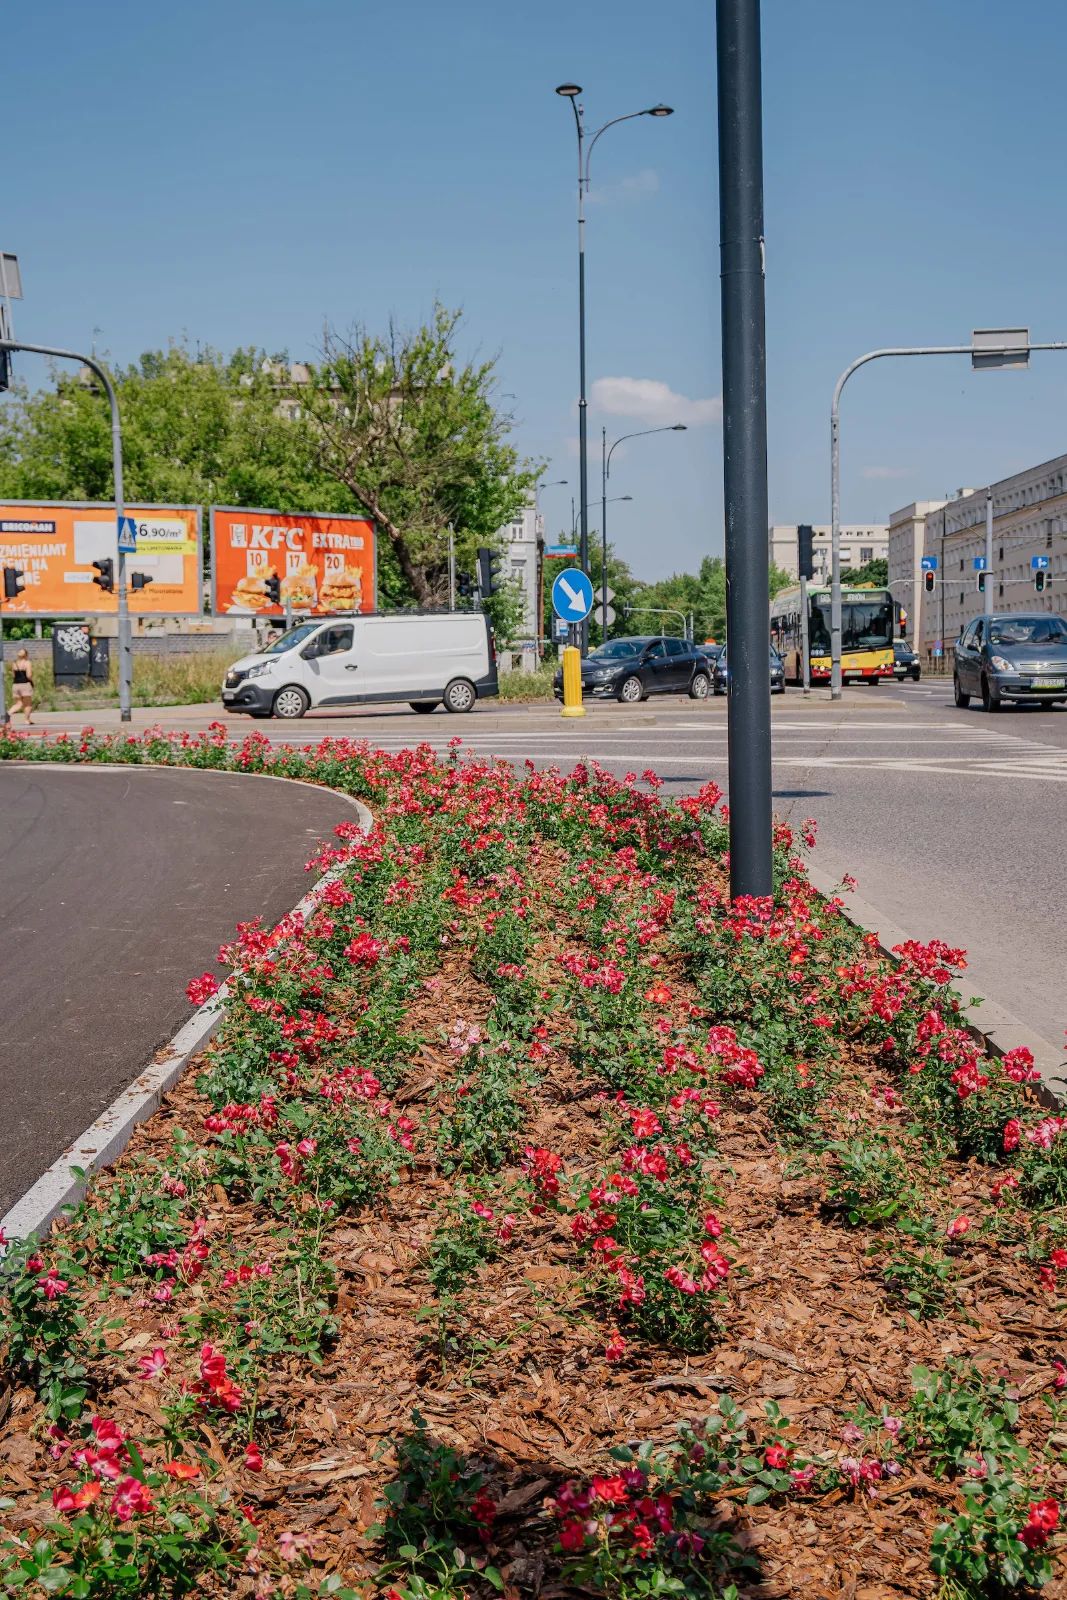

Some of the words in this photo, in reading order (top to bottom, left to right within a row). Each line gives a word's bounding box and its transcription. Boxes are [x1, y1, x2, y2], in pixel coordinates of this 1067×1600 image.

[1, 522, 53, 532] BRICOMAN
[249, 525, 304, 551] KFC
[311, 532, 351, 550] EXTRA
[0, 543, 67, 557] ZMIENIAMY
[32, 558, 49, 571] NA
[250, 553, 262, 566] 10
[289, 555, 300, 568] 17
[326, 556, 340, 569] 20
